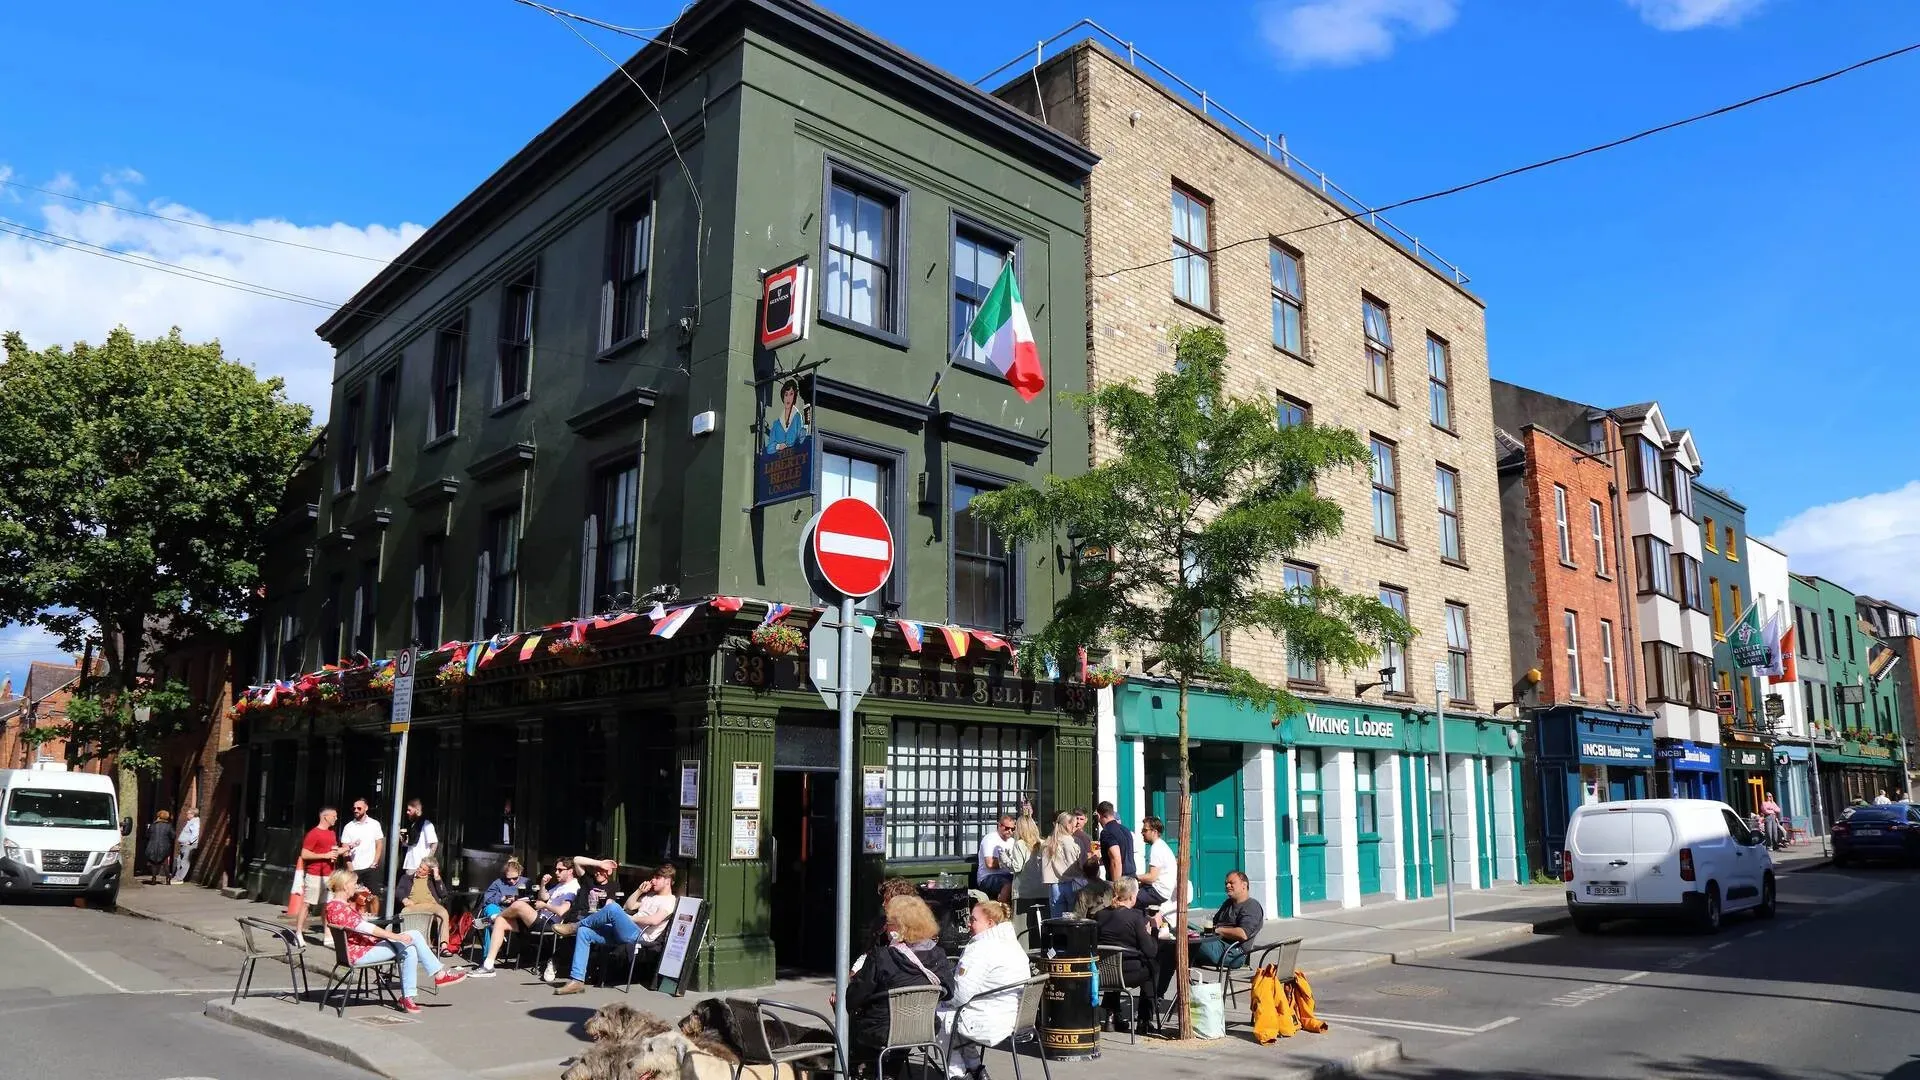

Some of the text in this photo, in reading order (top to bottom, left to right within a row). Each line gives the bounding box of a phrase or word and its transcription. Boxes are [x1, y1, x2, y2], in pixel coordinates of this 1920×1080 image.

[764, 453, 809, 475] LIBERTY
[769, 465, 802, 486] BELLE
[594, 662, 668, 694] BELLE
[734, 655, 765, 683] 33
[971, 677, 1043, 706] BELLE
[1065, 687, 1089, 711] 33
[1306, 712, 1395, 738] VIKING LODGE
[1607, 745, 1622, 758] Home
